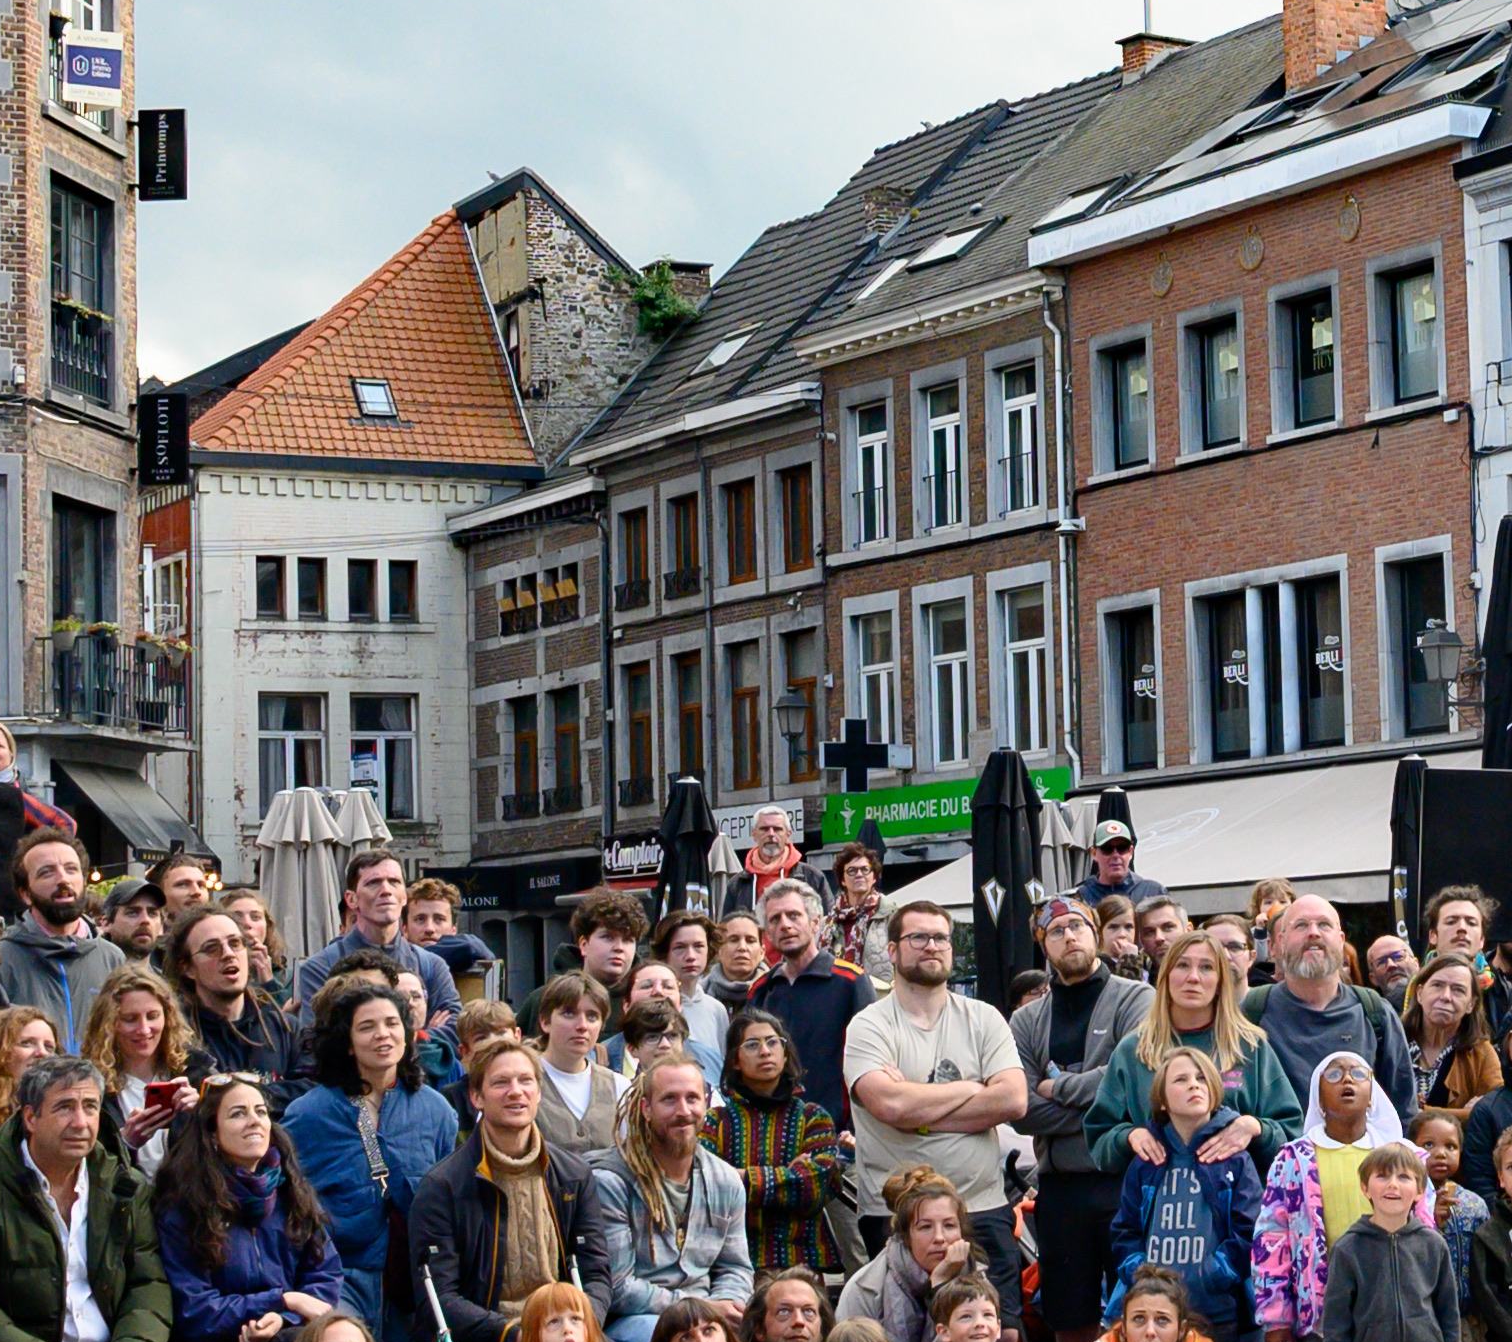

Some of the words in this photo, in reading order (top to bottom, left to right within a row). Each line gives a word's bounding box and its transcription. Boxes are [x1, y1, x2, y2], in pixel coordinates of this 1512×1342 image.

[155, 113, 169, 183] Printemps
[155, 398, 169, 465] SOFLOTI
[865, 799, 938, 823] PHARMACIE
[940, 797, 958, 817] DU
[612, 837, 661, 874] Comptoir
[461, 896, 499, 907] ALONE
[1162, 1167, 1201, 1196] IT'S
[1160, 1201, 1196, 1230] ALL
[1148, 1235, 1205, 1265] GOOD
